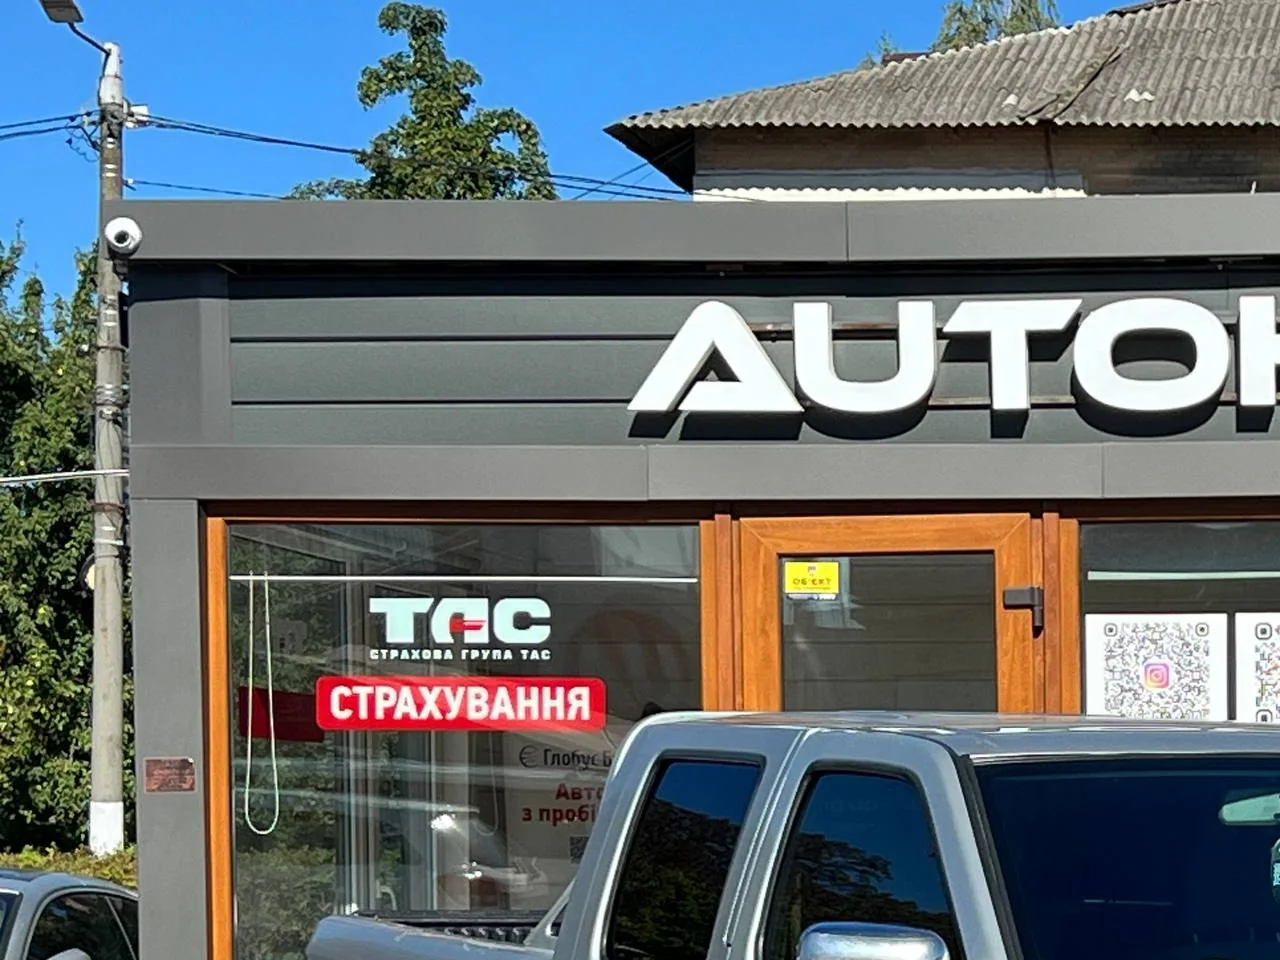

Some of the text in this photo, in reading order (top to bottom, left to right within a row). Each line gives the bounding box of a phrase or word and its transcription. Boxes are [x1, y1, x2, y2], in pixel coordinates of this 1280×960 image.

[369, 597, 551, 644] ТАС
[369, 648, 551, 660] СТРАХОВА ГРУПА ТАС
[330, 685, 591, 721] СТРАХУВАННЯ
[538, 804, 596, 827] пробі
